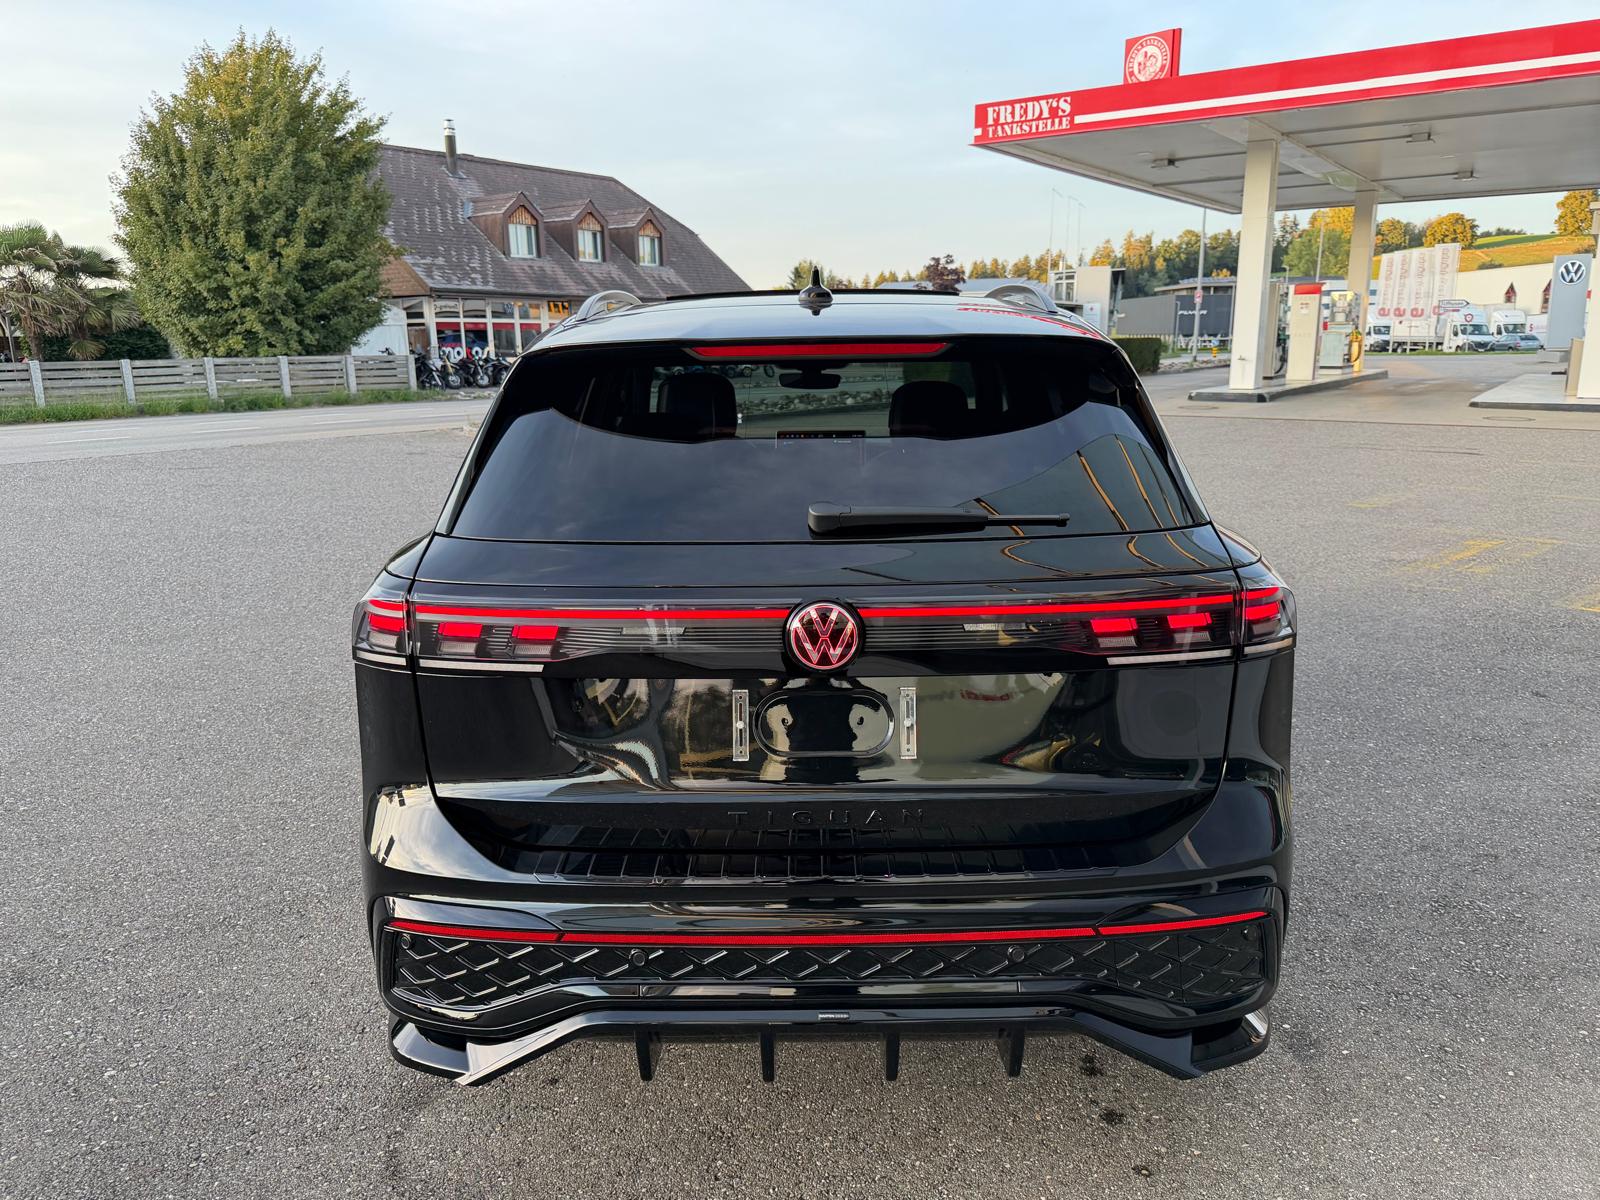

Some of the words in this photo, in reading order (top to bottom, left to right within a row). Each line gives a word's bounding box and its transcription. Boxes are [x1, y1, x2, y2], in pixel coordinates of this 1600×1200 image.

[987, 97, 1071, 125] FREDY'S
[987, 117, 1070, 138] TANKSTELLE
[727, 808, 925, 826] TIGUAN
